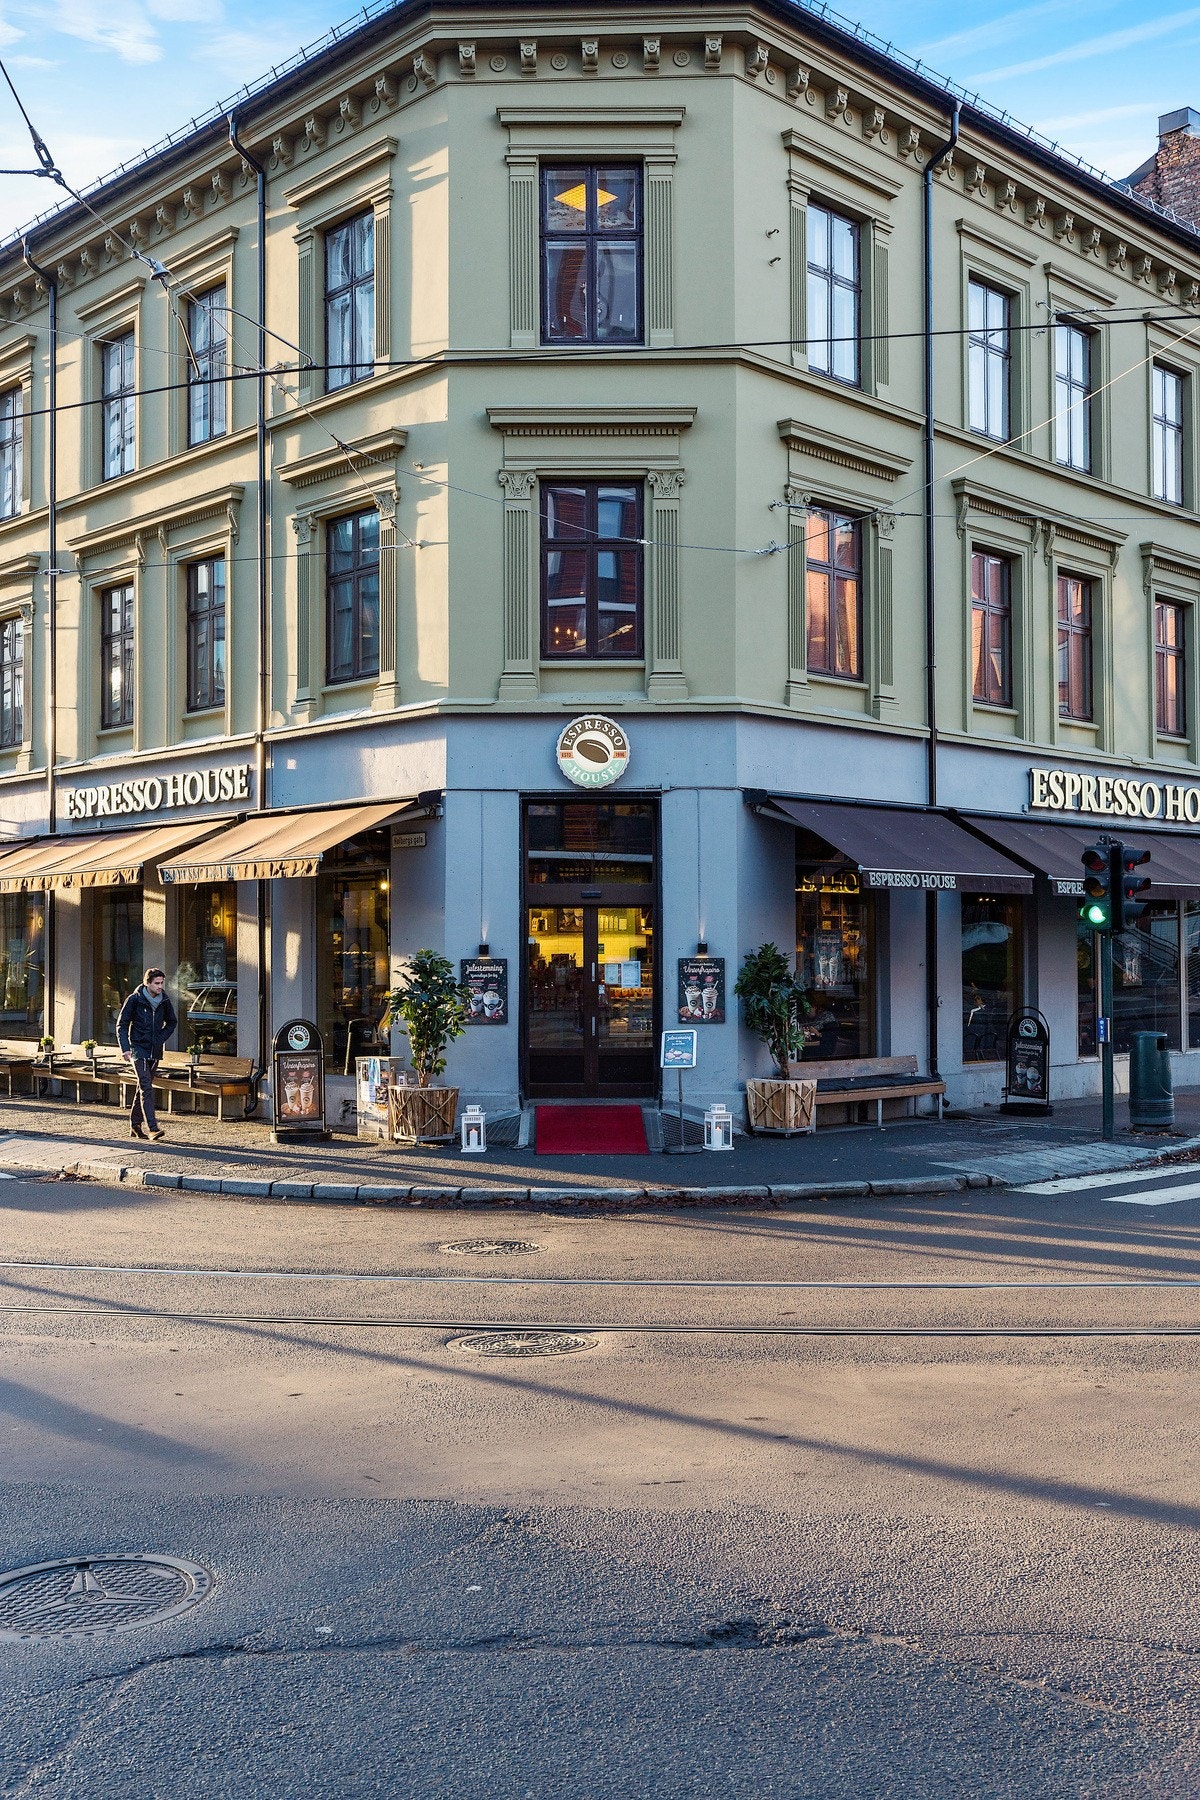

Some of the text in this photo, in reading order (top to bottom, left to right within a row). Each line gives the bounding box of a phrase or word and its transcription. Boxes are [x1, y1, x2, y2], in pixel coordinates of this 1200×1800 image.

[563, 719, 623, 746] ESPRESSO
[570, 766, 617, 783] HOUSE
[64, 764, 250, 820] ESPRESSO HOUSE
[1032, 768, 1161, 818] ESPRESSO
[869, 871, 957, 889] ESPRESSO HOUSE
